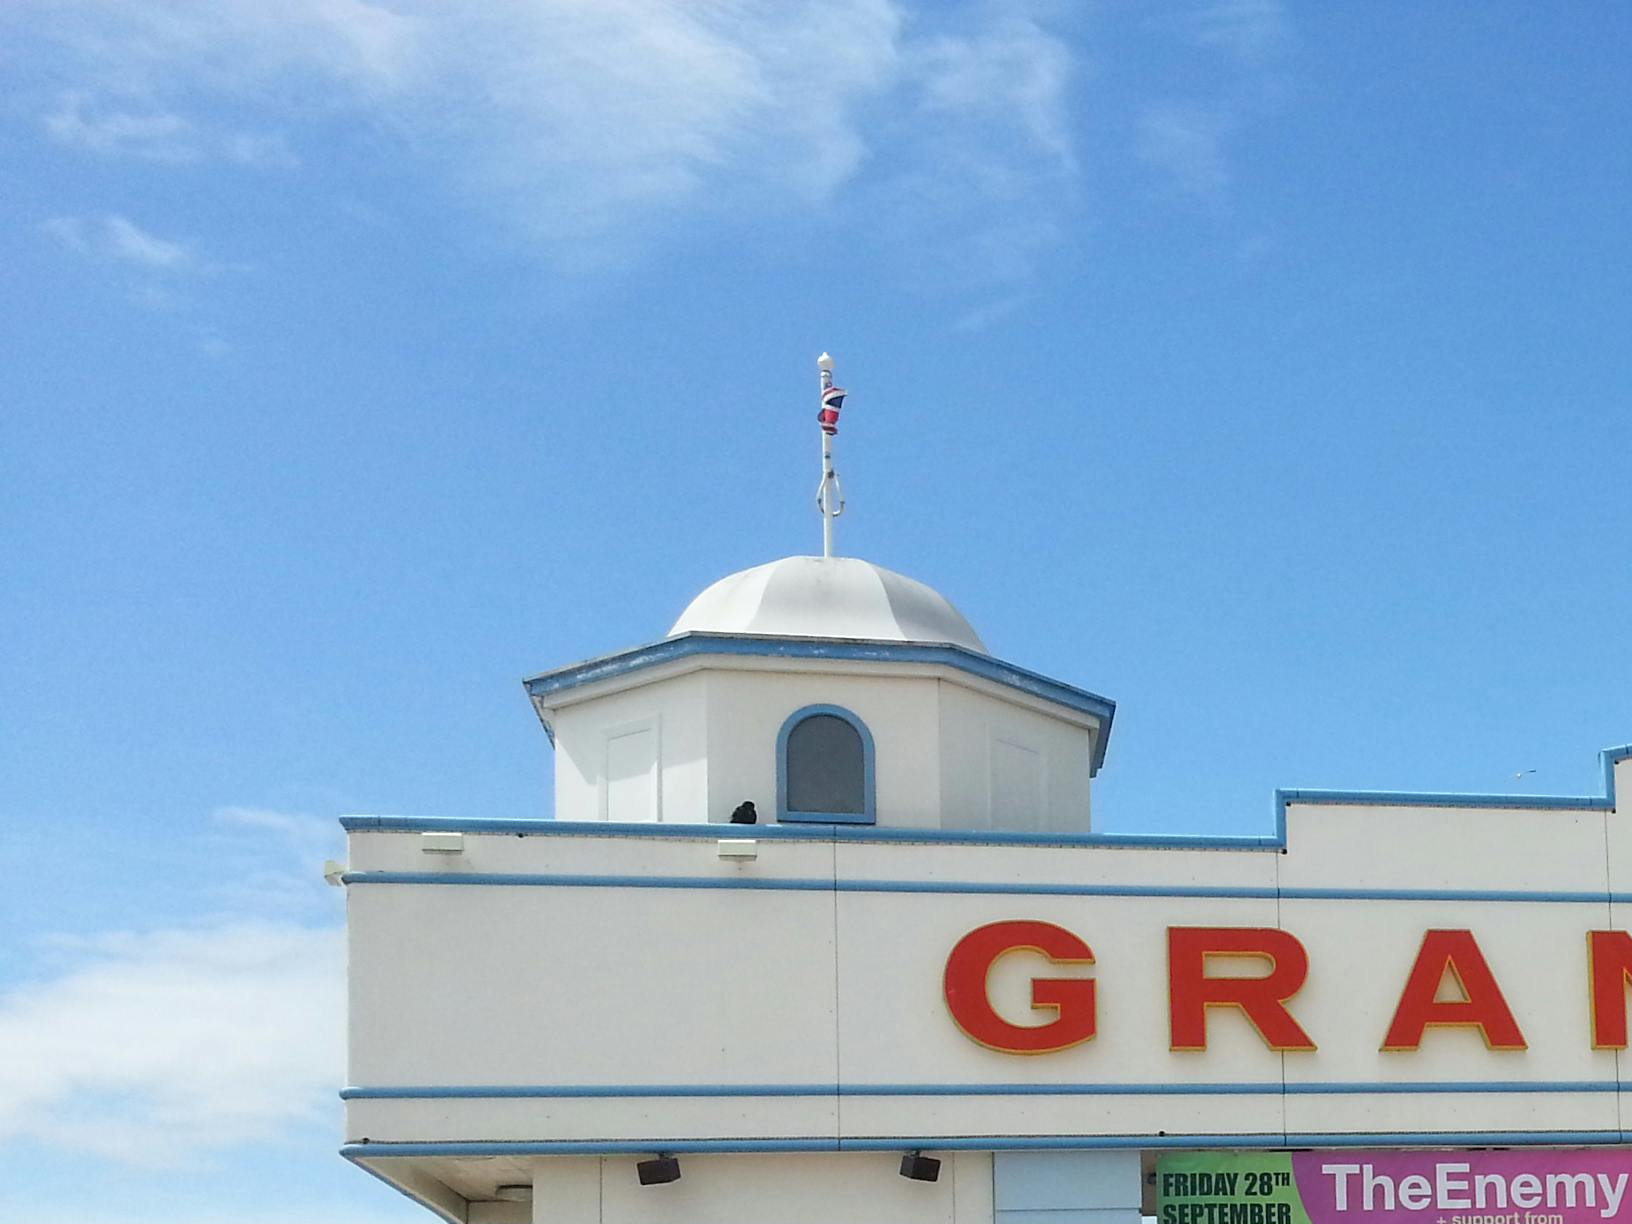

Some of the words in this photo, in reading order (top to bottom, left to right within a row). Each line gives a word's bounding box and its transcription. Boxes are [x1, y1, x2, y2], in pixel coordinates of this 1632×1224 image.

[1162, 1172, 1238, 1197] FRIDAY
[1244, 1172, 1291, 1196] 28TH
[1321, 1162, 1629, 1219] TheEnemy
